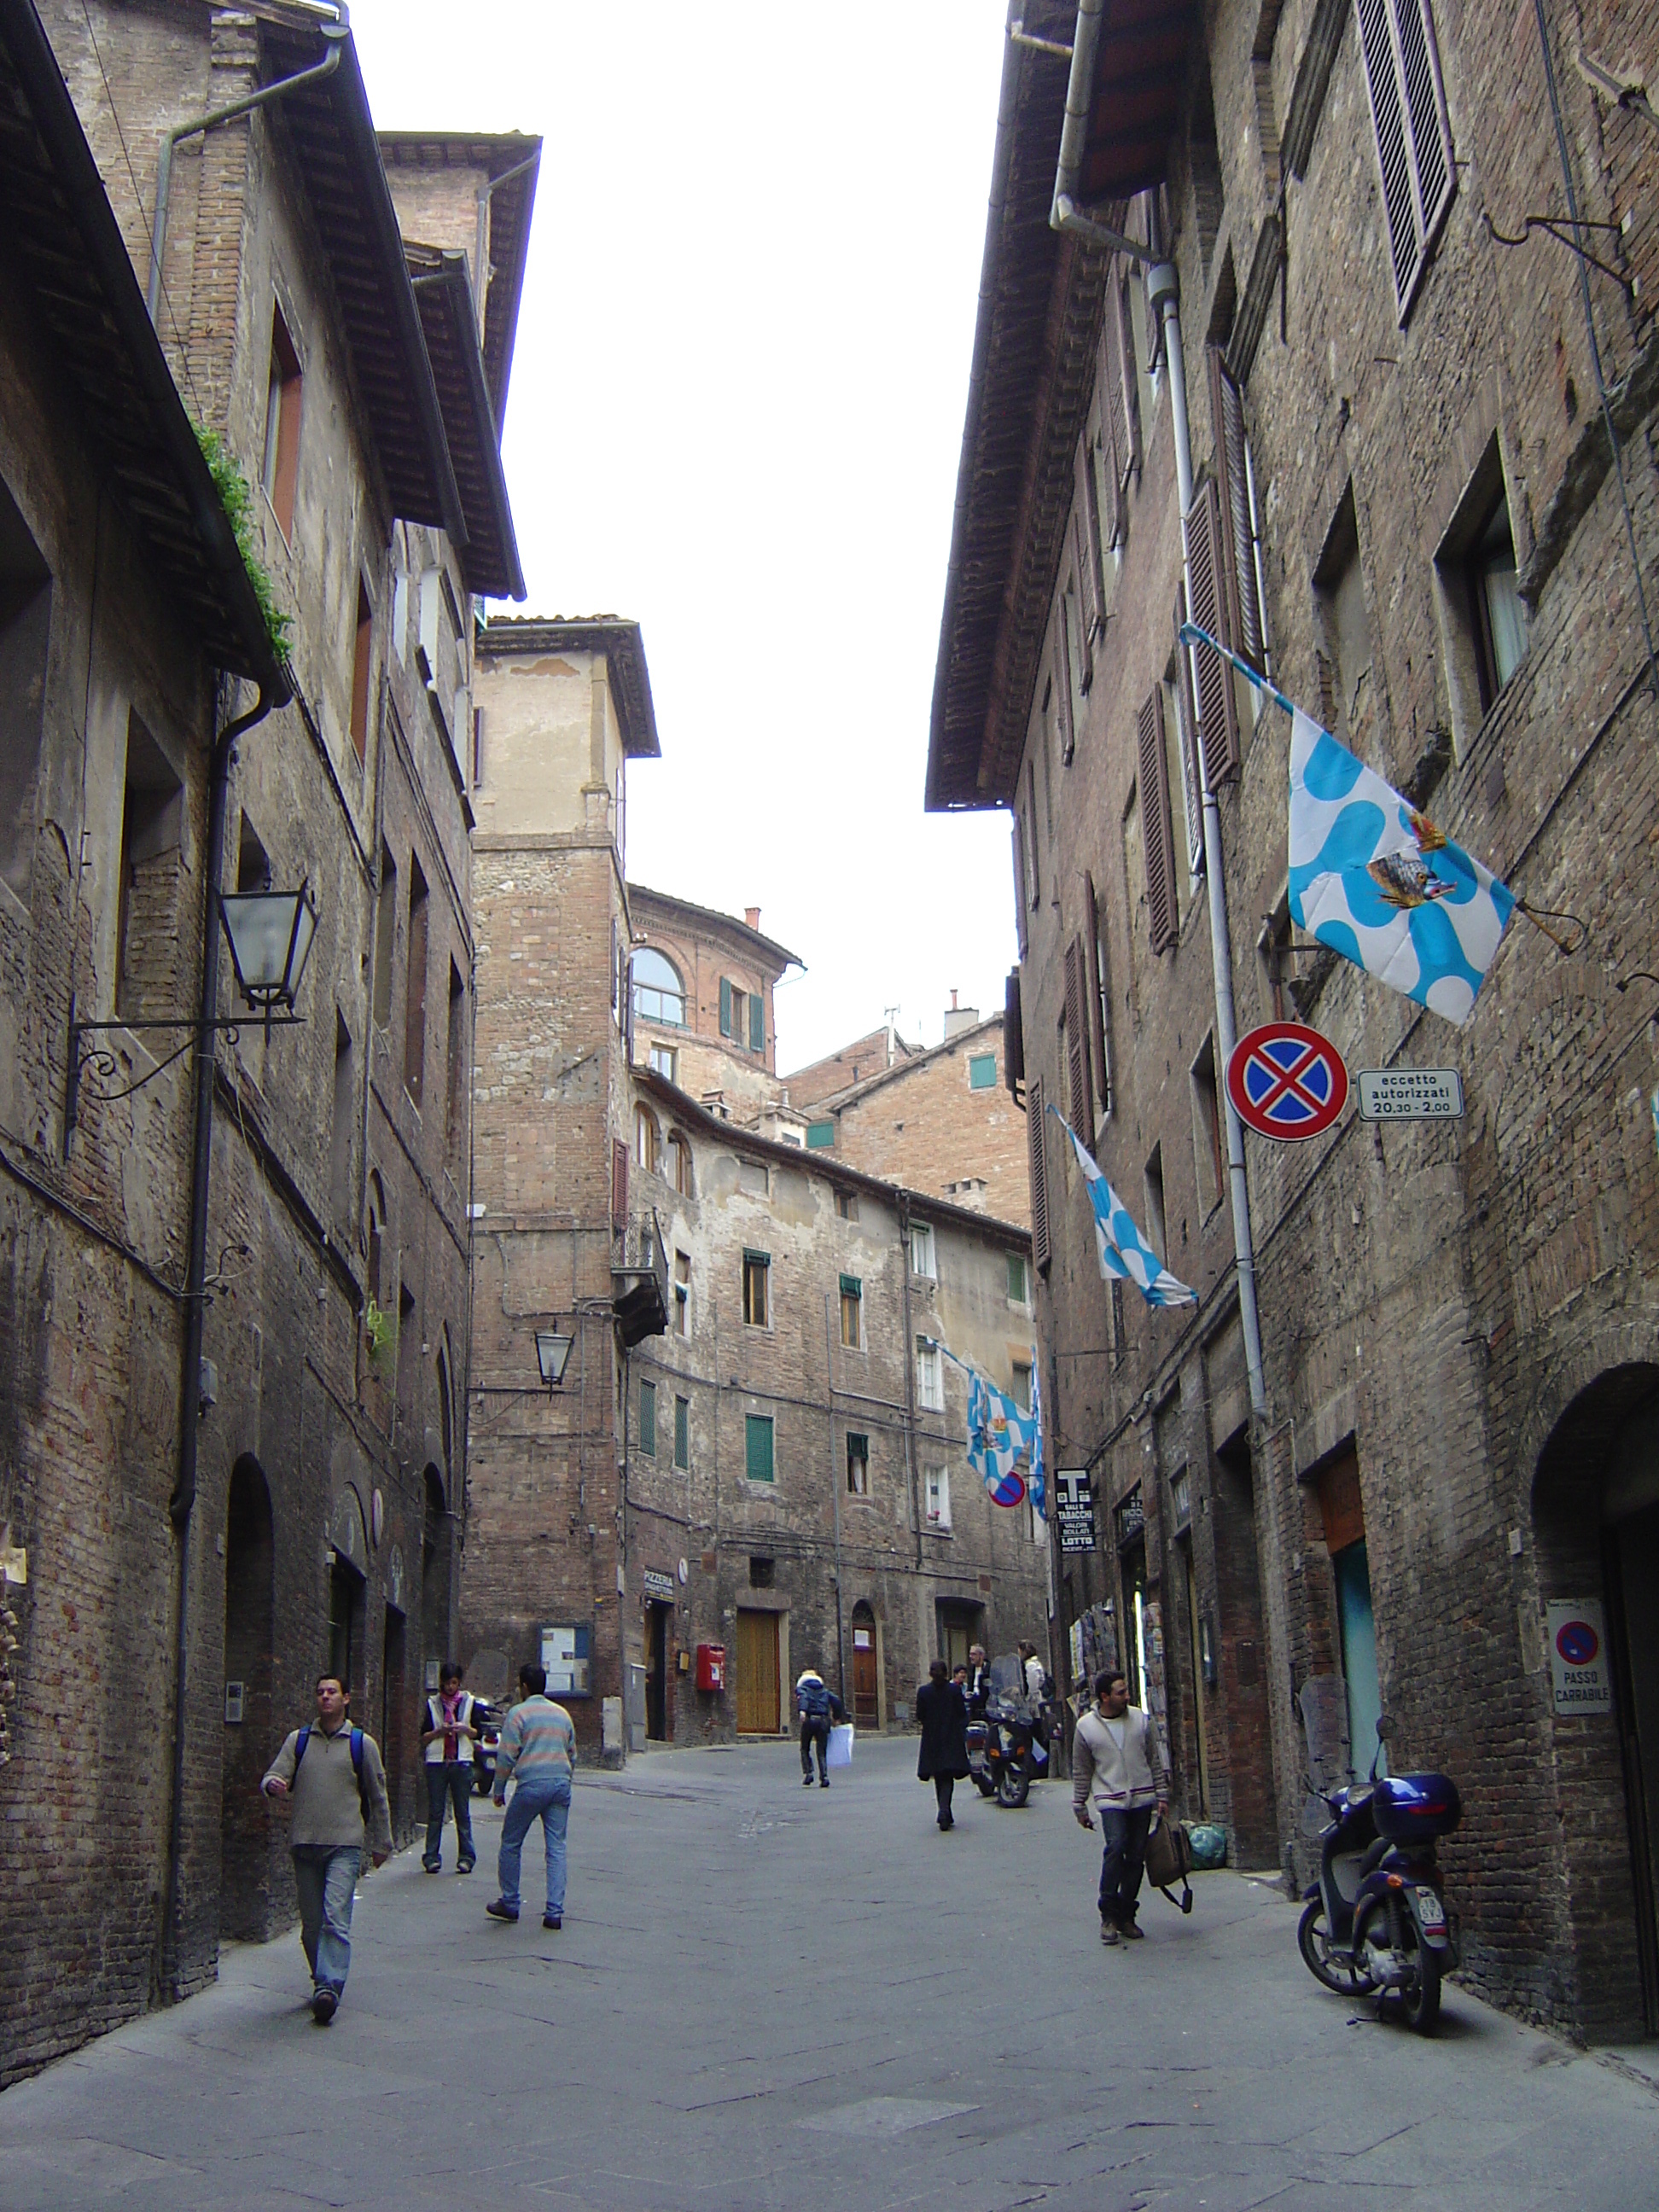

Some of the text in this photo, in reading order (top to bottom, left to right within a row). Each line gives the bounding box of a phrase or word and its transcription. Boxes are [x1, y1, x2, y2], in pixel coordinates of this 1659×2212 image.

[1382, 1074, 1437, 1085] eccetto
[1371, 1087, 1449, 1099] autorizzati
[1057, 1470, 1087, 1502] T
[1057, 1510, 1092, 1520] TABACCHI
[1061, 1537, 1092, 1545] LOTTO
[644, 1569, 673, 1587] PIZZERIA
[1564, 1671, 1598, 1684] PASSO
[1556, 1688, 1610, 1703] CARRABILE
